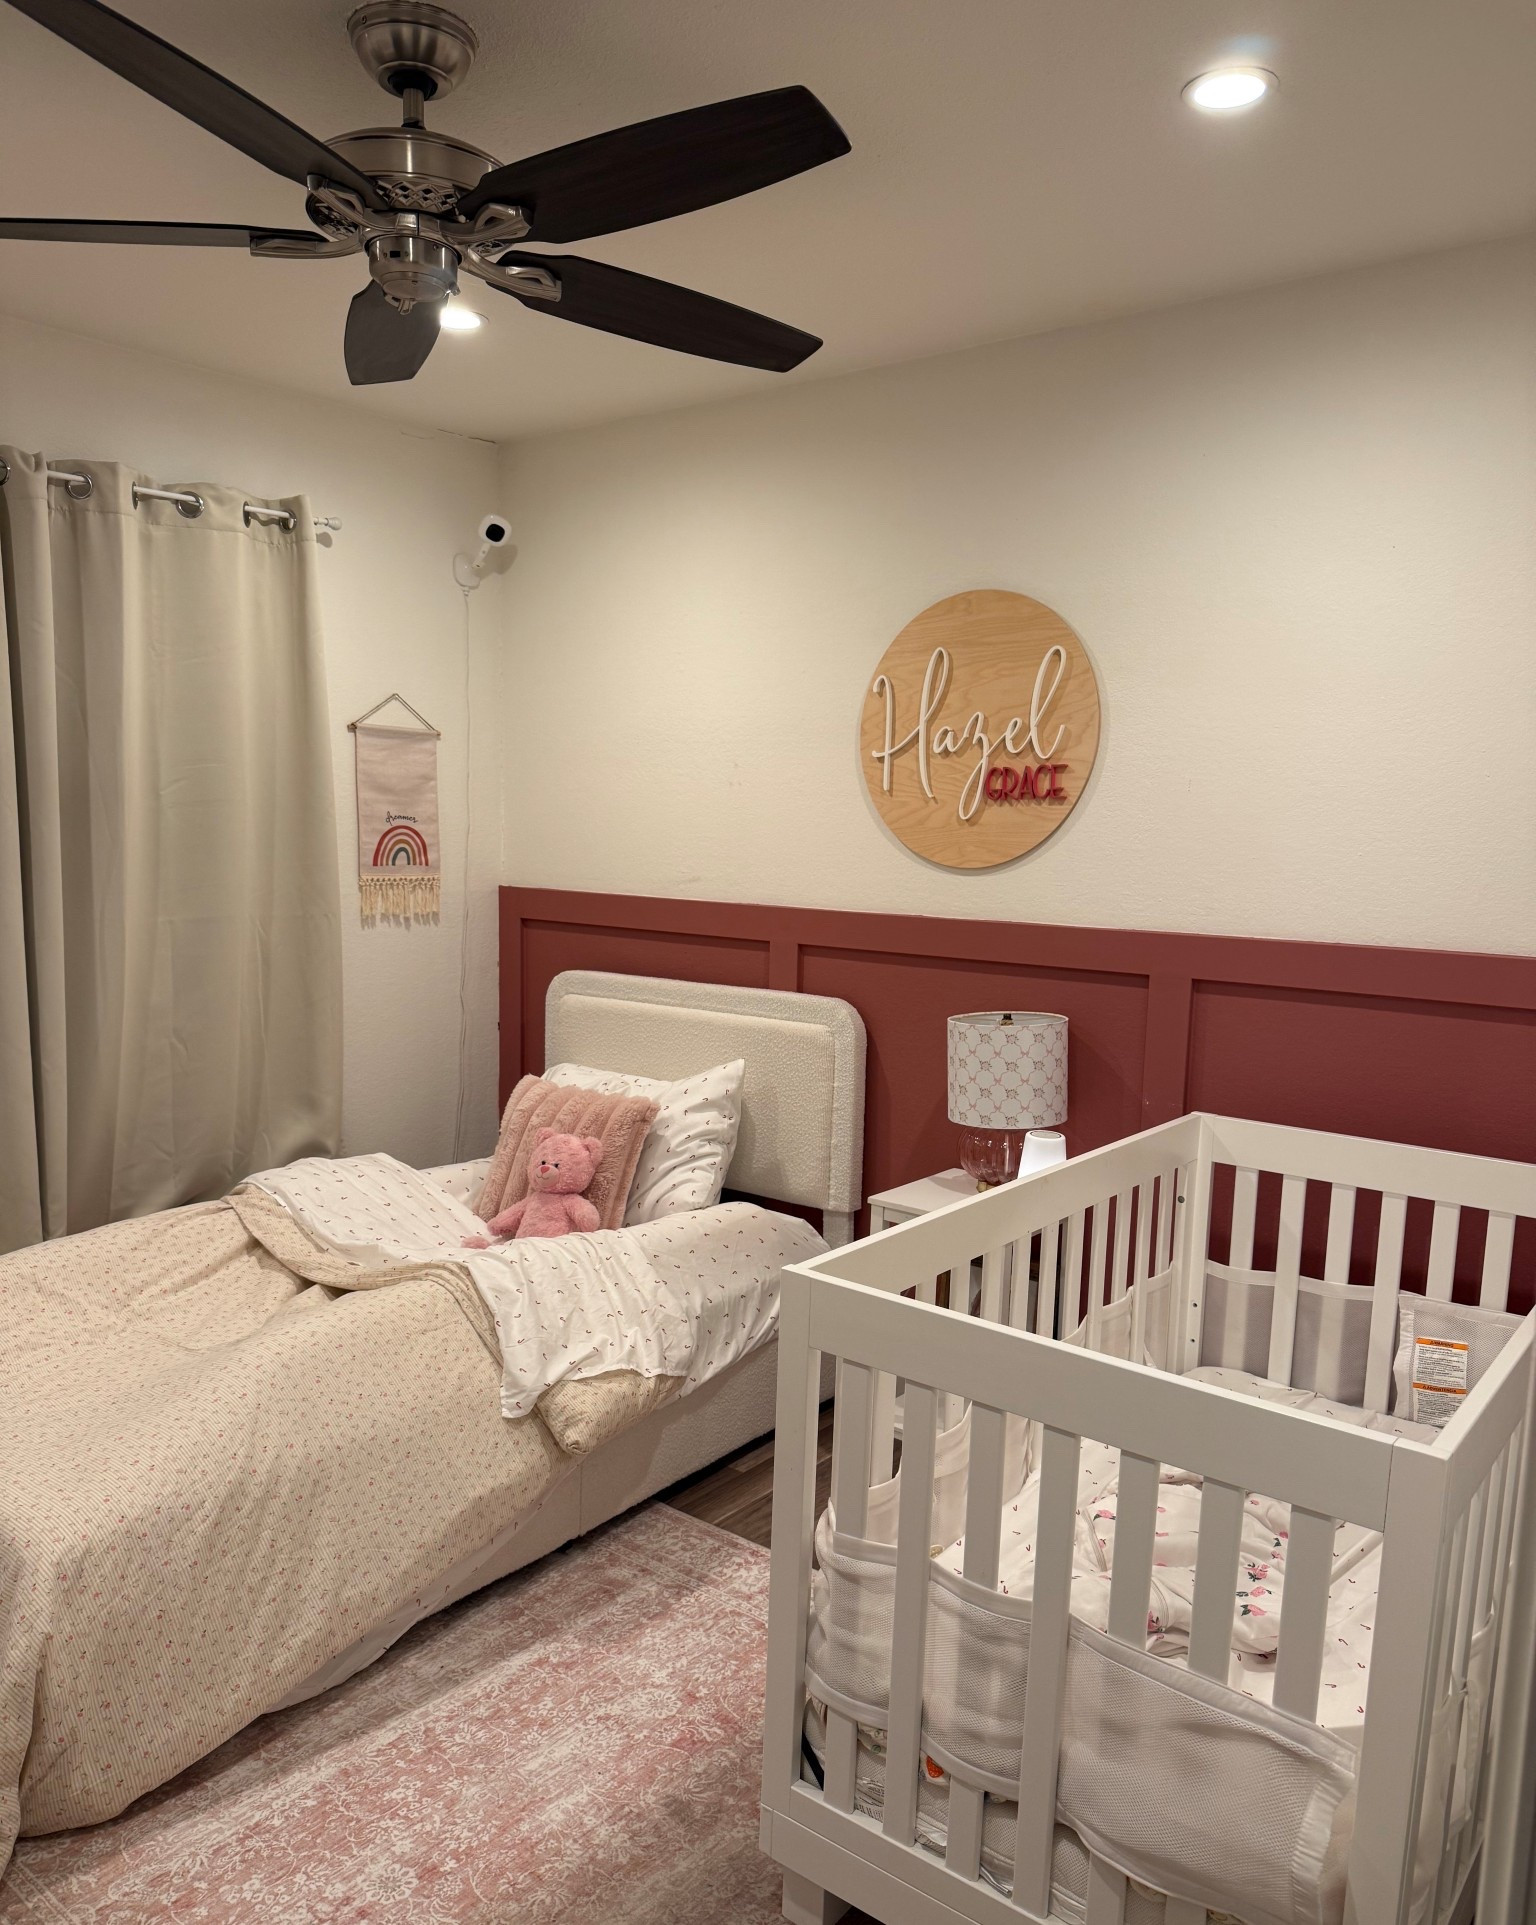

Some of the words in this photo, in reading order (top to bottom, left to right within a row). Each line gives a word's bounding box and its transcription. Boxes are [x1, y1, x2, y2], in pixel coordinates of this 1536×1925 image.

[872, 645, 1066, 820] Hazel
[985, 764, 1068, 800] GRACE
[385, 811, 418, 826] dreamer
